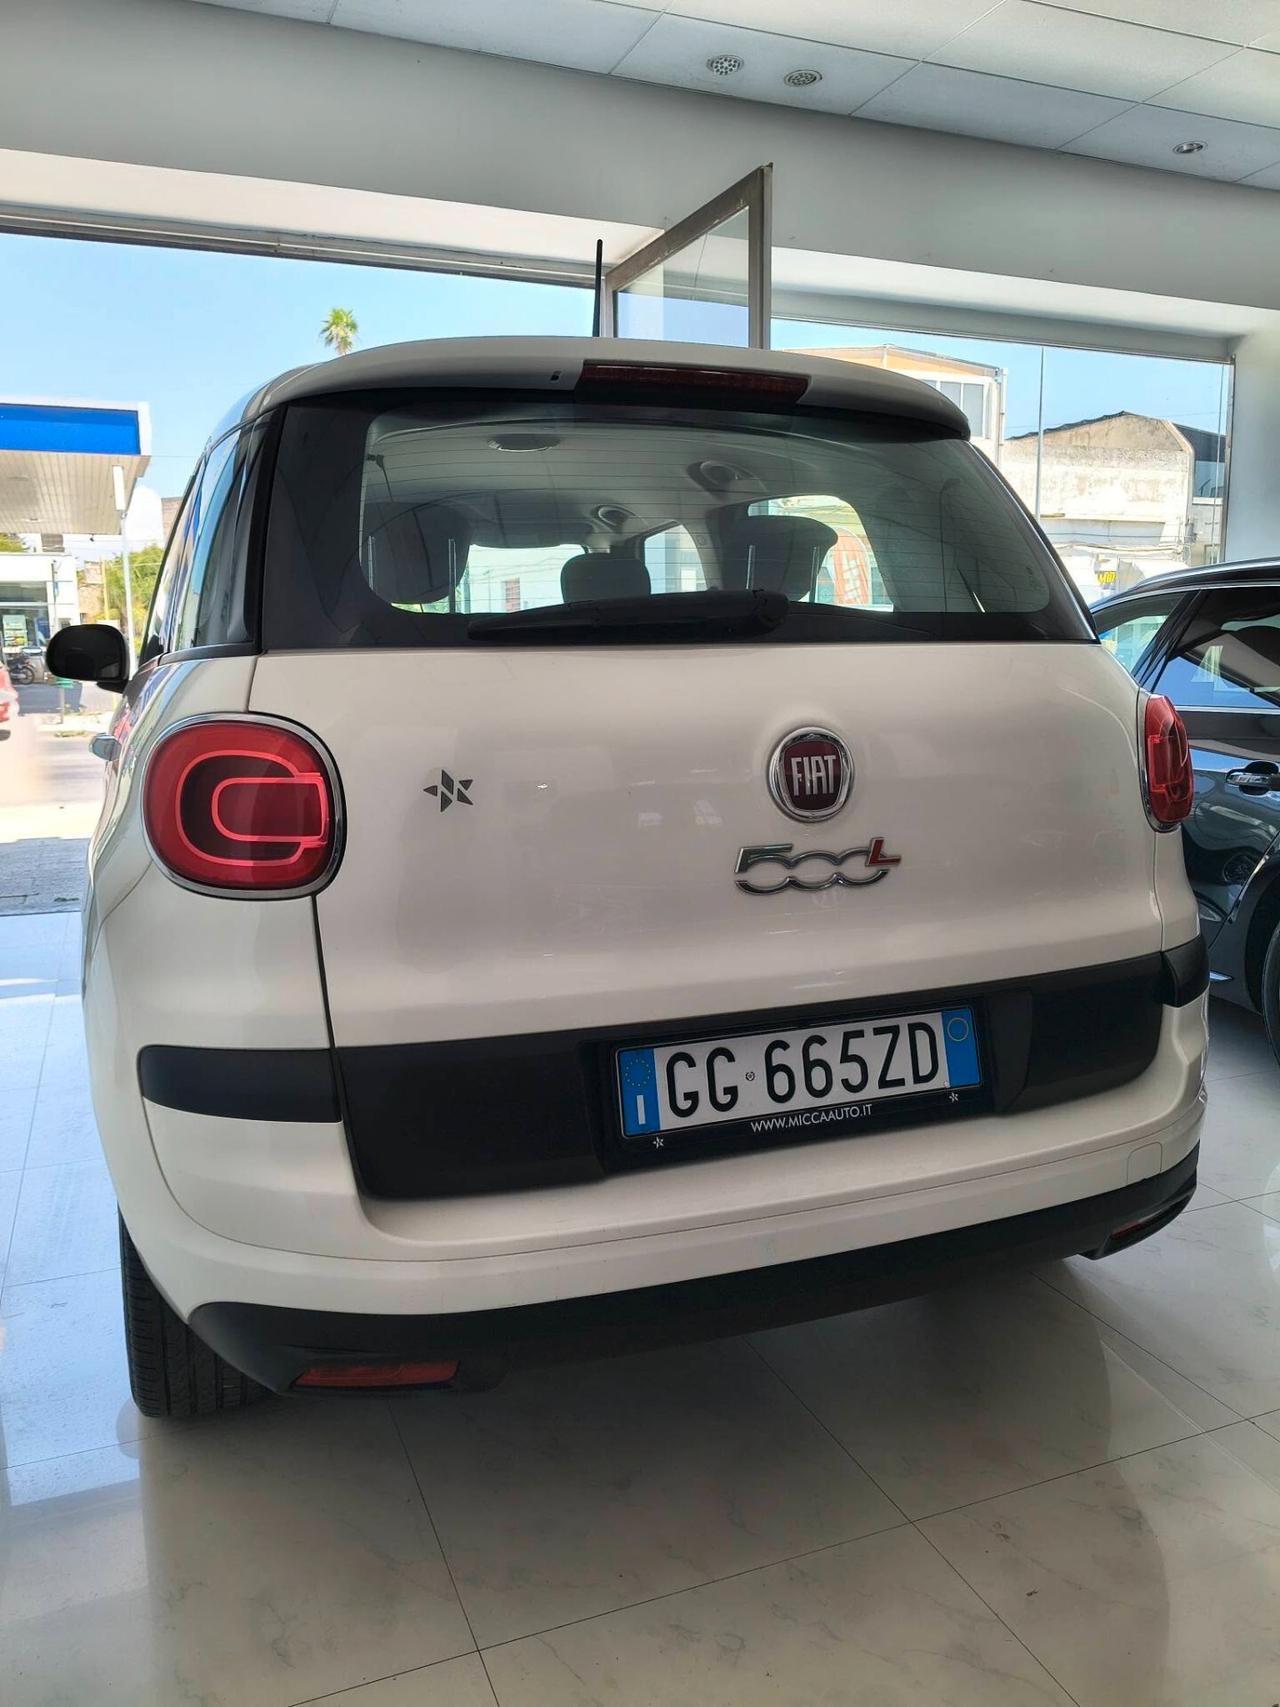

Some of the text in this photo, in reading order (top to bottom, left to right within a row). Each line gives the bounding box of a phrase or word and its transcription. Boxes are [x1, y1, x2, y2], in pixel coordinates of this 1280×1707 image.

[790, 755, 836, 796] FIAT
[666, 1047, 739, 1118] GG
[764, 1021, 940, 1104] 665ZD
[750, 1103, 873, 1133] WWW.MICCAAUTO.IT
